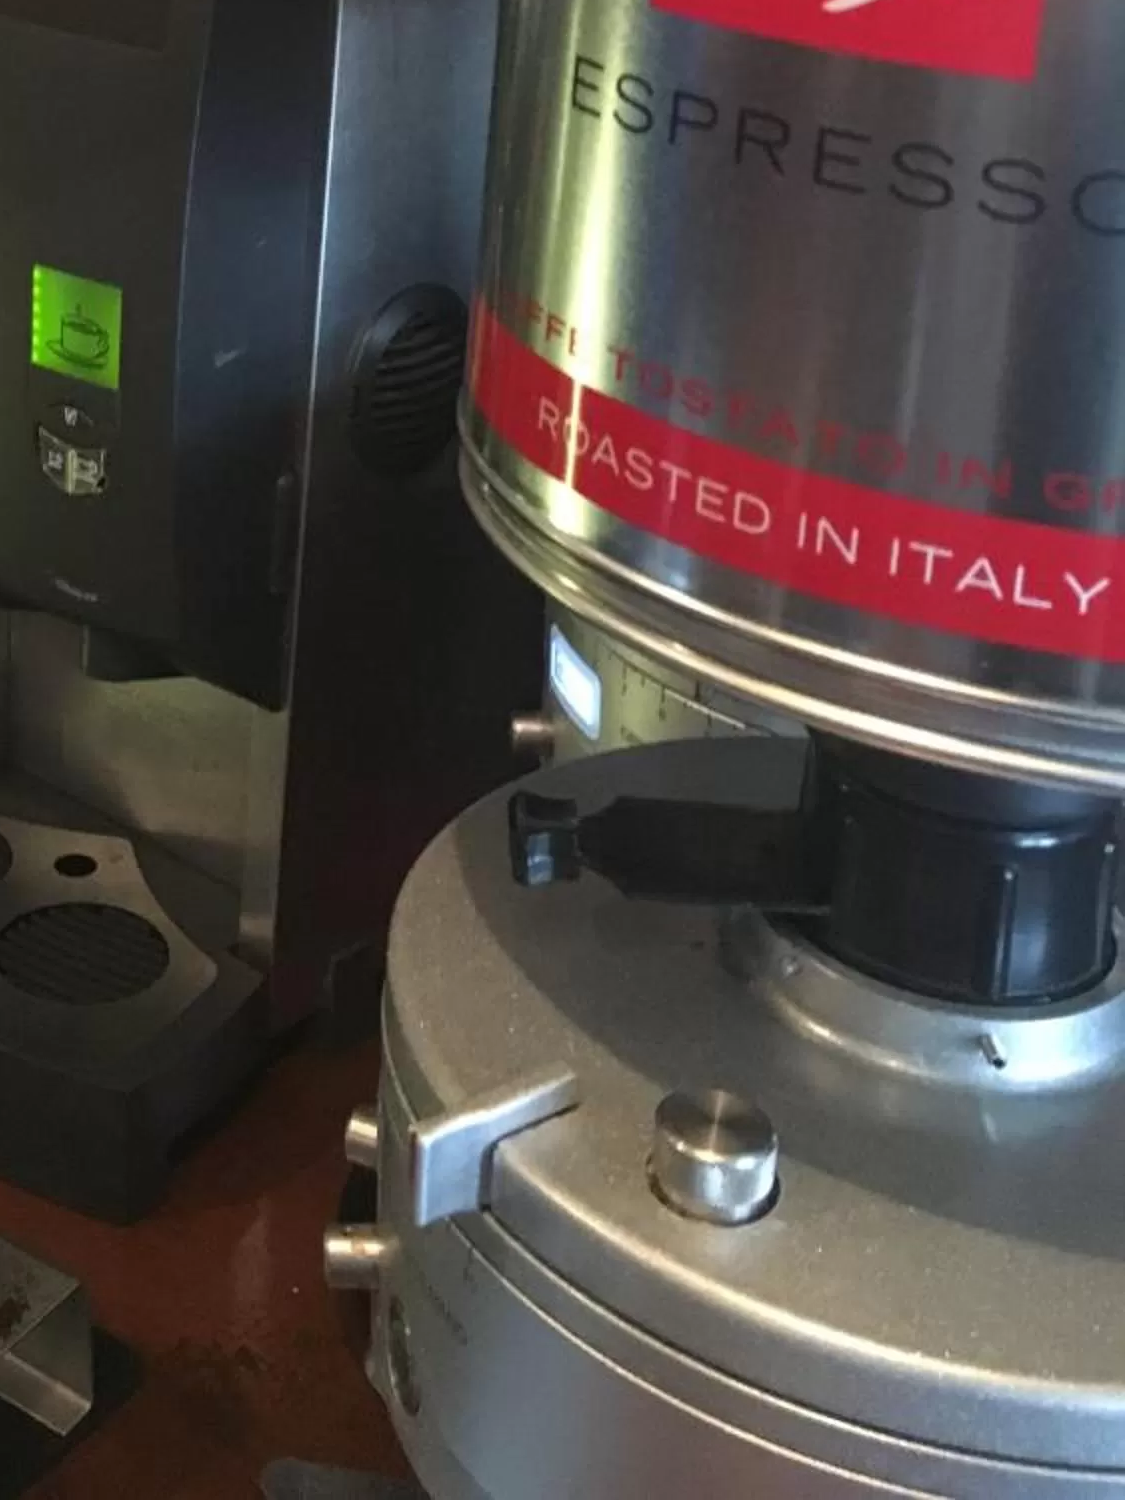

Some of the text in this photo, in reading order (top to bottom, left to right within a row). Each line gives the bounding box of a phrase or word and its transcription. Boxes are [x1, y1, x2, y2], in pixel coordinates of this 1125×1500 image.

[537, 396, 1111, 617] ROASTED IN ITALY
